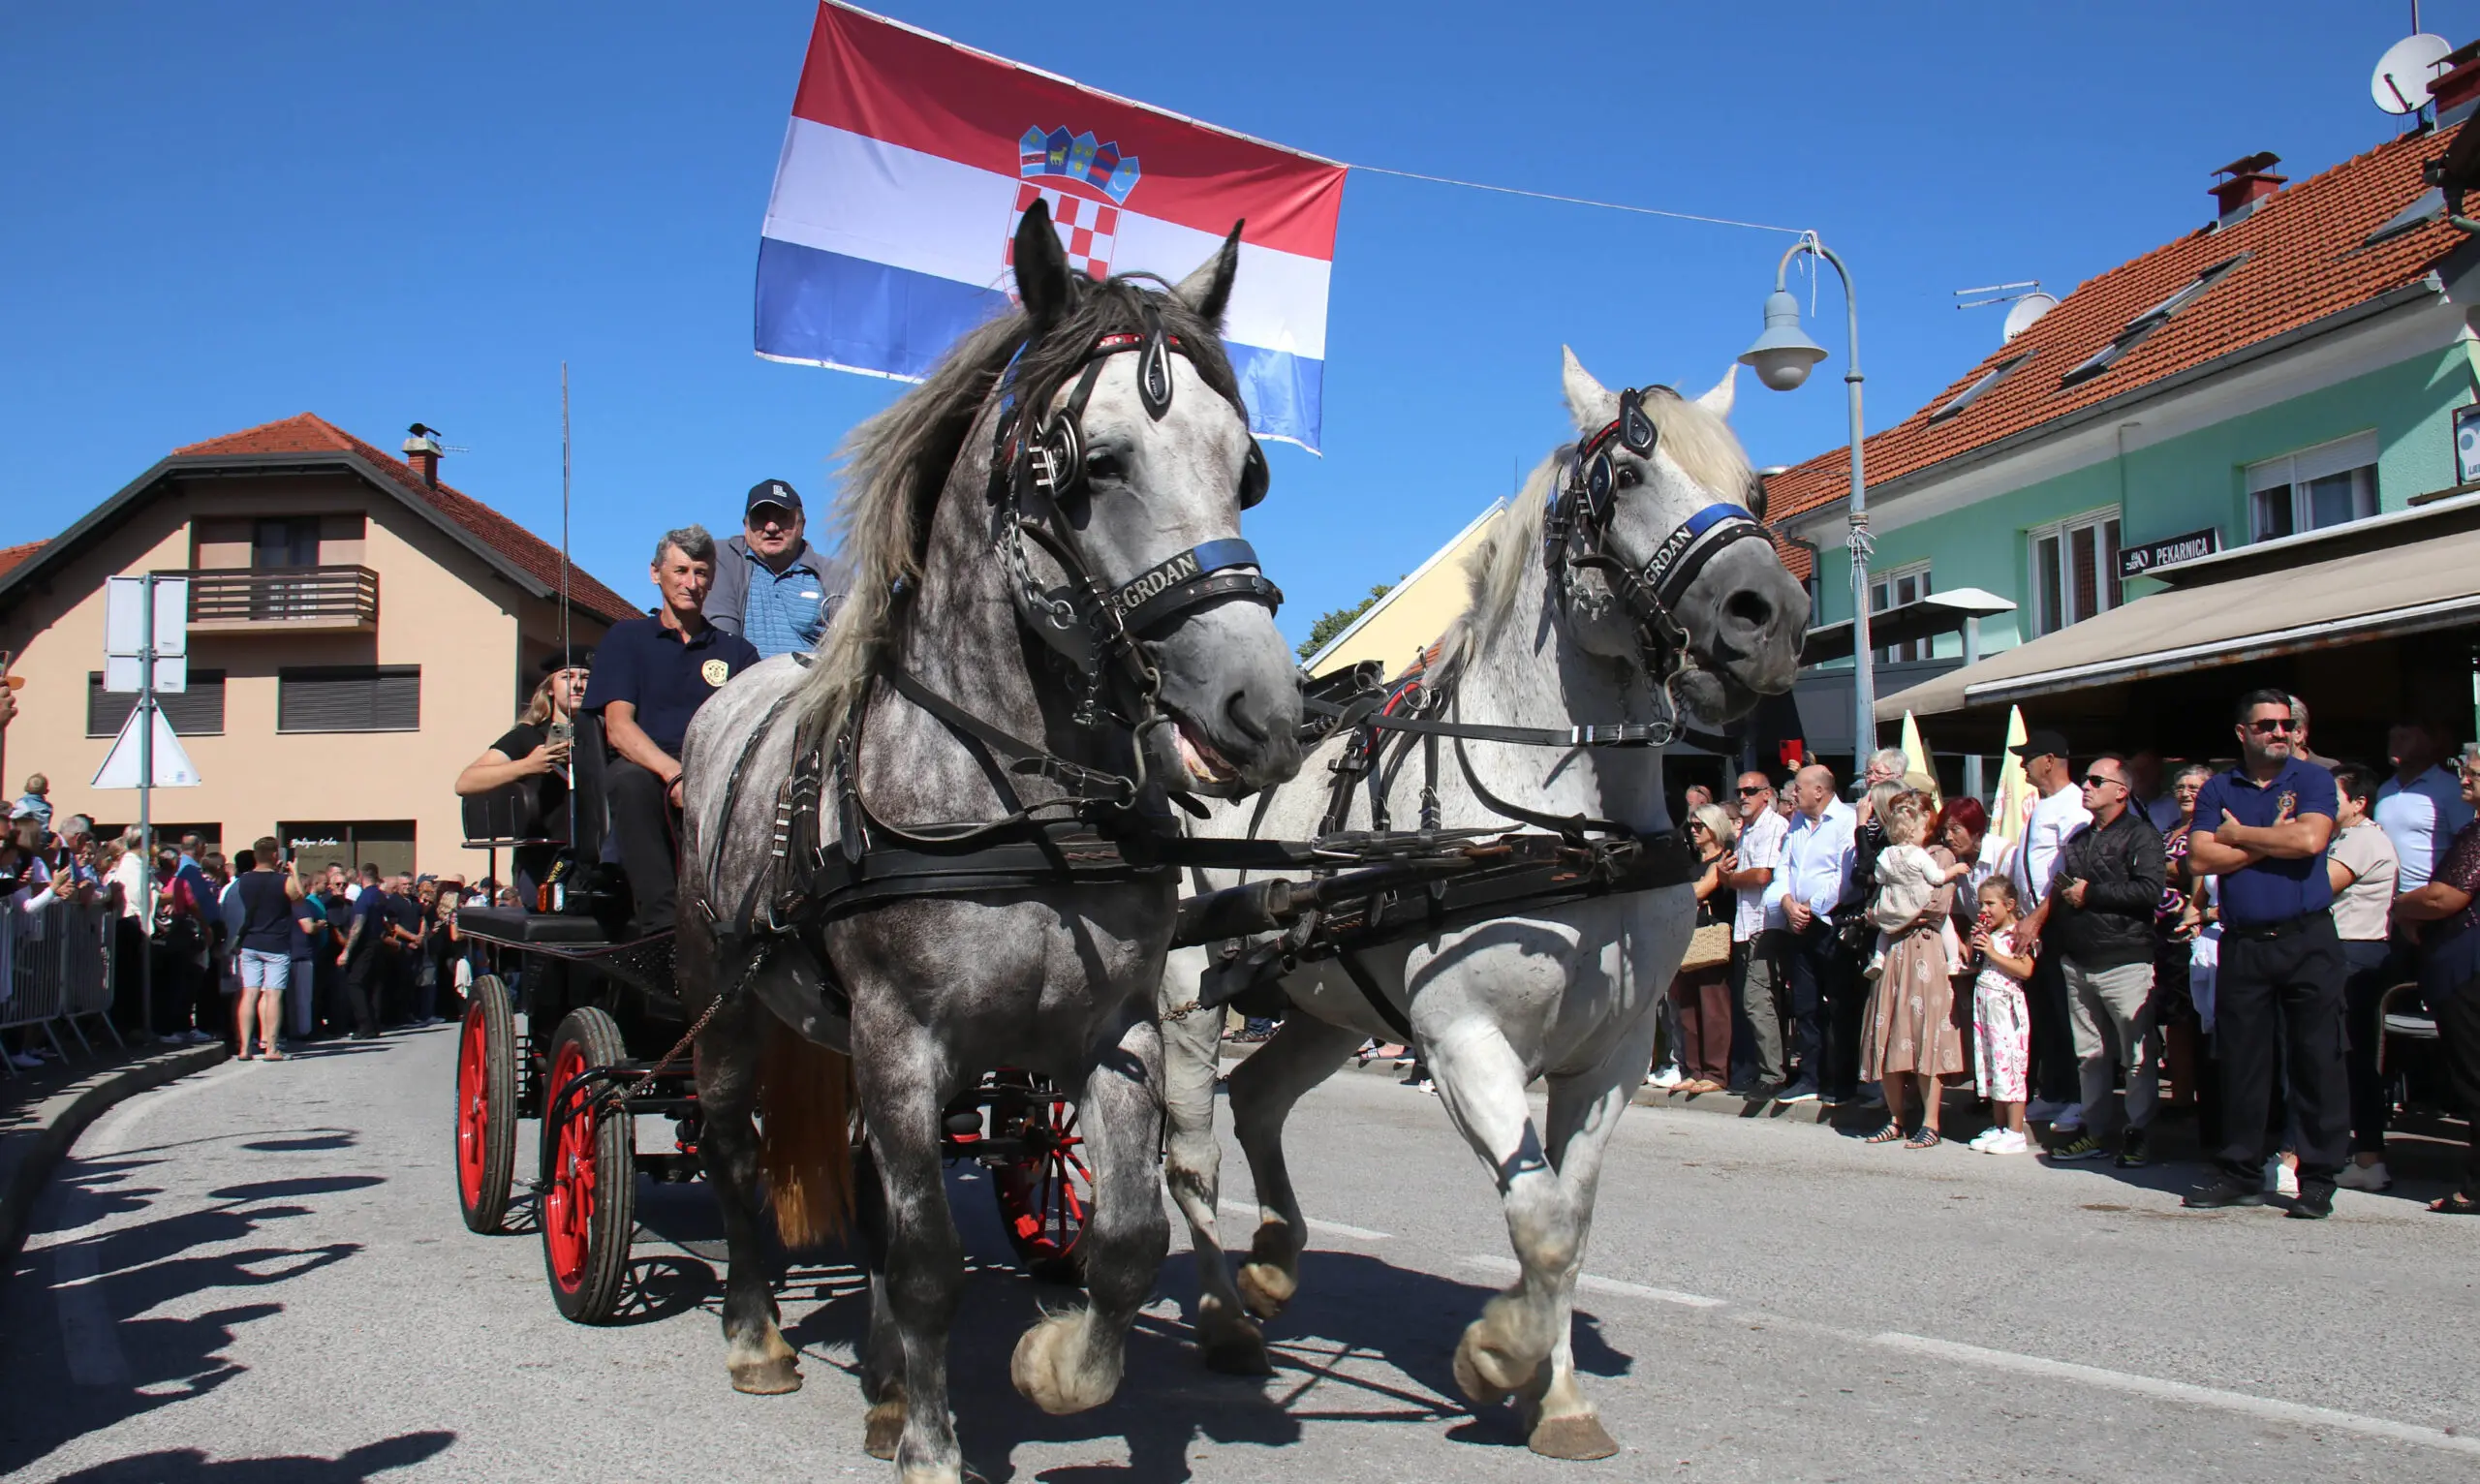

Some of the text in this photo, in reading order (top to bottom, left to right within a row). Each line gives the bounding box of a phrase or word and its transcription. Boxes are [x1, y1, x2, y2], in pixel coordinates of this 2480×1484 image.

[1643, 526, 1692, 586] GRDAN
[2156, 538, 2209, 566] PEKARNICA
[1123, 553, 1198, 608] GRDAN
